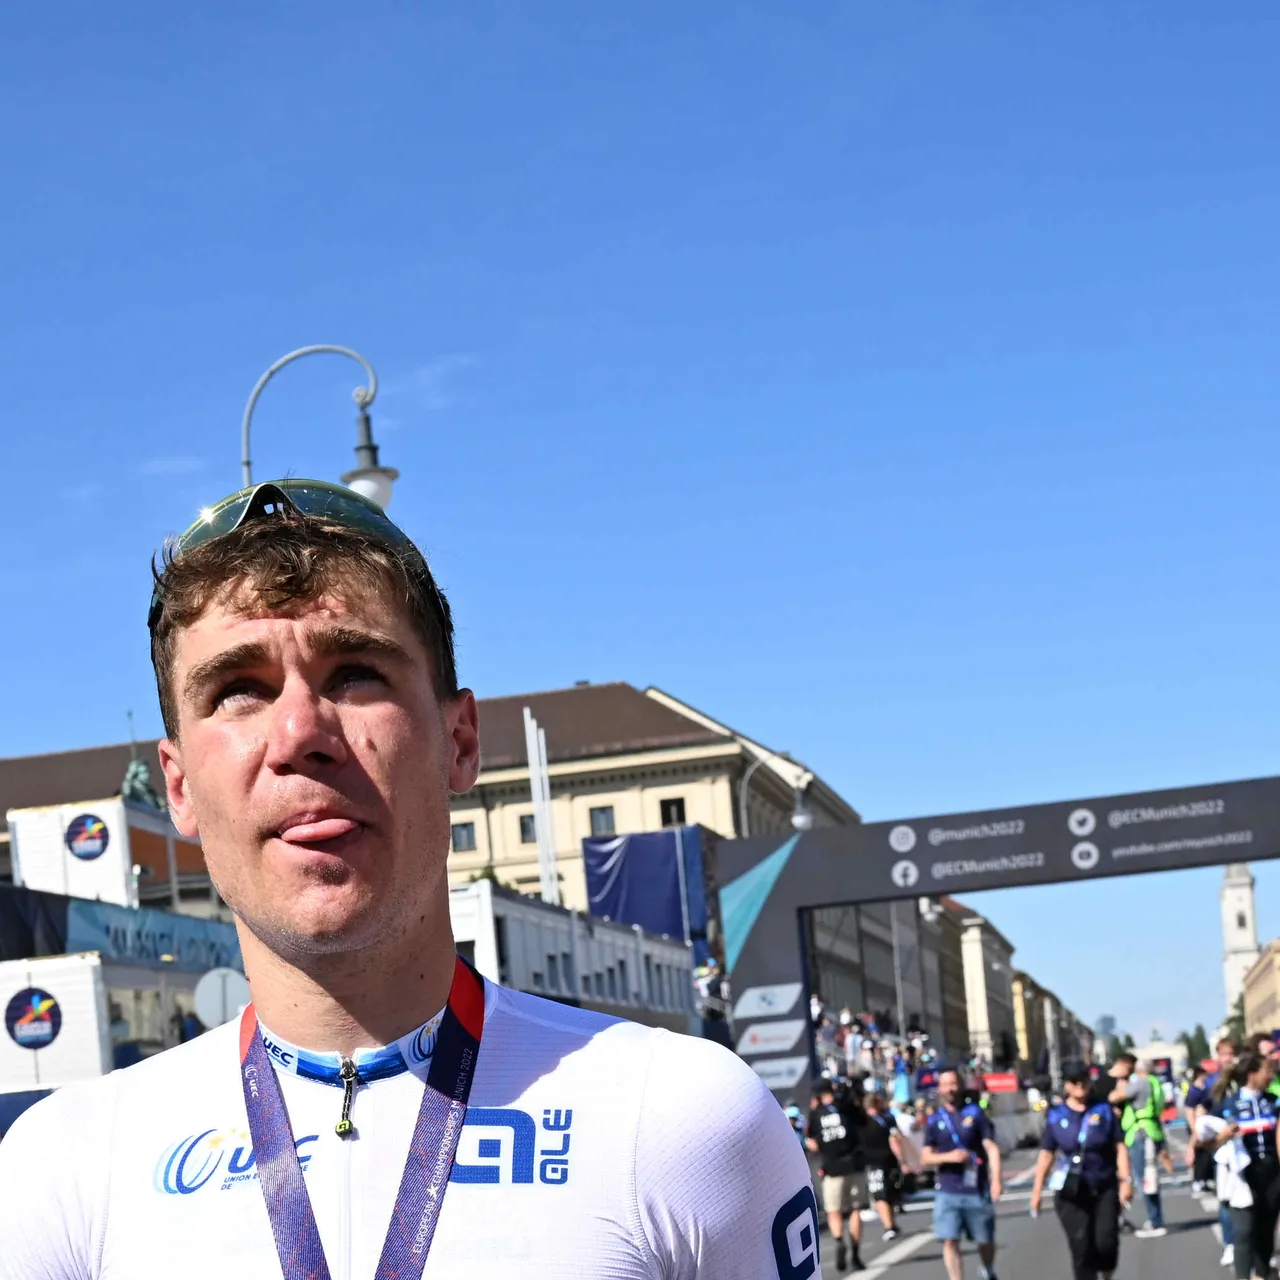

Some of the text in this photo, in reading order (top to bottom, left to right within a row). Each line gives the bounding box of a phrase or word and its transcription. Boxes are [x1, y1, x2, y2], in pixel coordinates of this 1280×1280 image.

[928, 820, 1025, 845] @munich2022
[262, 1036, 294, 1065] UEC
[249, 1079, 259, 1099] UEC
[414, 1048, 474, 1254] EUROPEAN CHAMPIONSHIPS MUNICH 2022
[220, 1183, 232, 1191] DE
[224, 1174, 251, 1183] UNION
